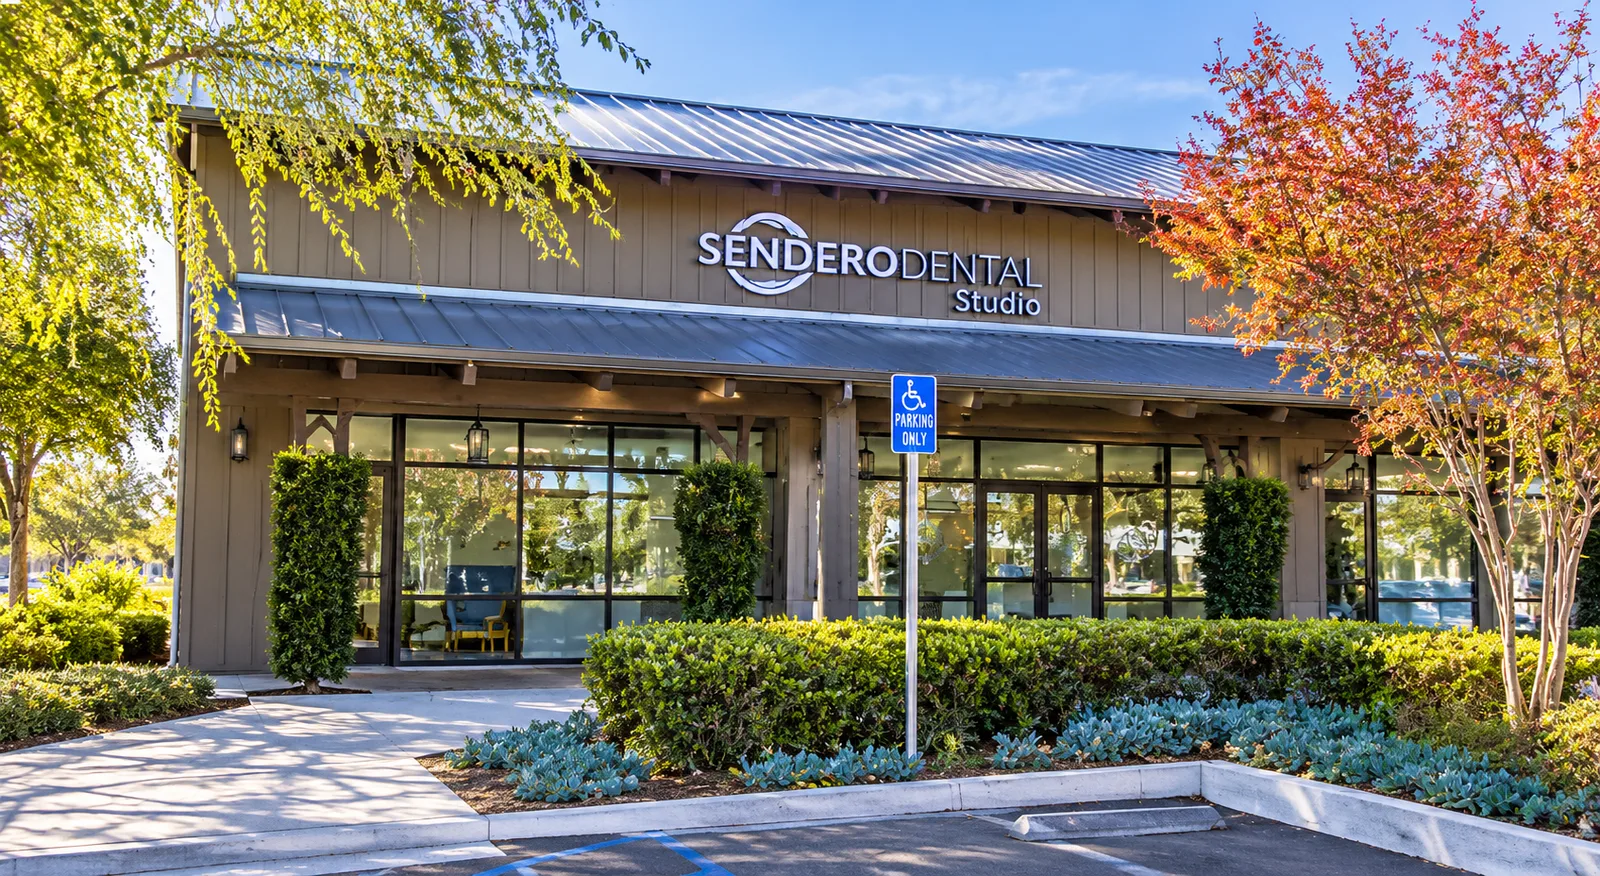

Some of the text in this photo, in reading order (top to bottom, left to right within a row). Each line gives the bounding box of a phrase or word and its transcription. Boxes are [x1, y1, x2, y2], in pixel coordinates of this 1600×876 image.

[955, 289, 1041, 316] Studio
[895, 413, 933, 428] PARKING
[902, 431, 927, 446] ONLY
